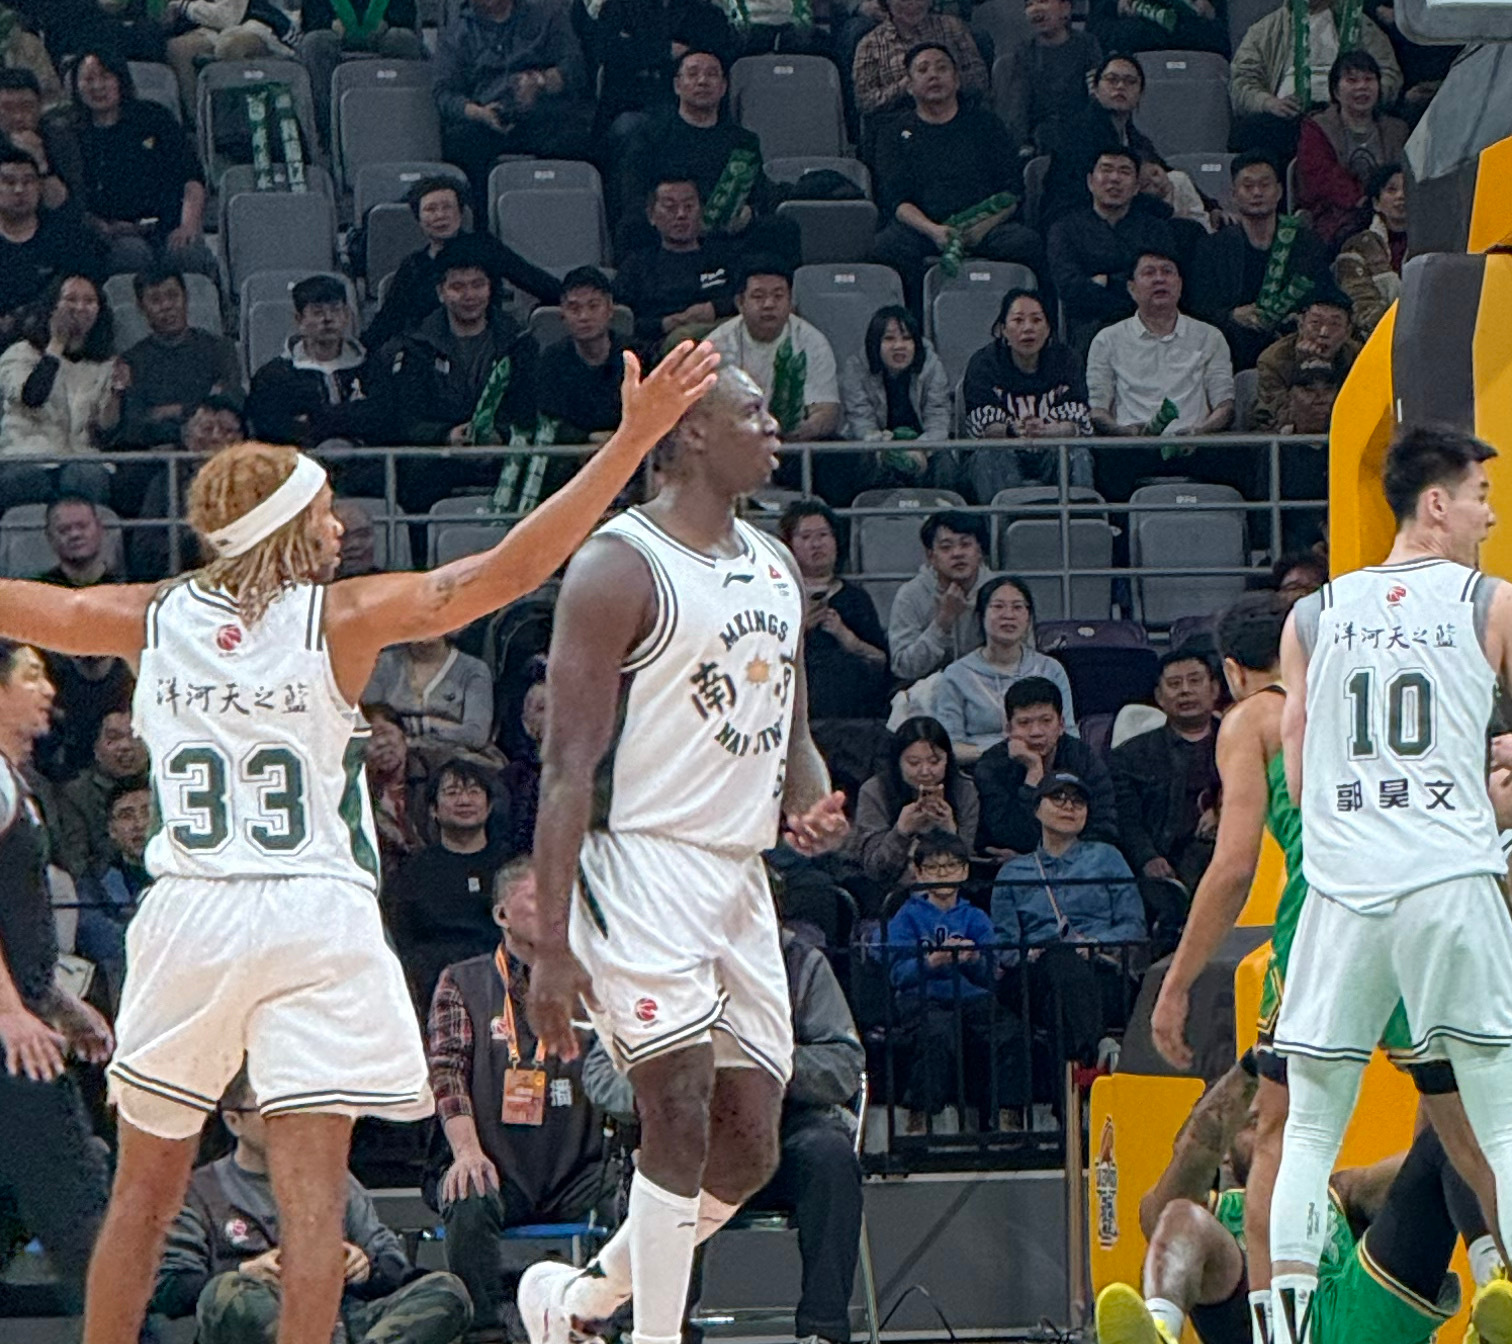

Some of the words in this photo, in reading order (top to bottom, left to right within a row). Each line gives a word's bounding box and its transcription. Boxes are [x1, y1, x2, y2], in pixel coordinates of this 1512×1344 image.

[1345, 668, 1437, 759] 10
[164, 742, 312, 855] 33
[1336, 778, 1456, 812] 郭昊文
